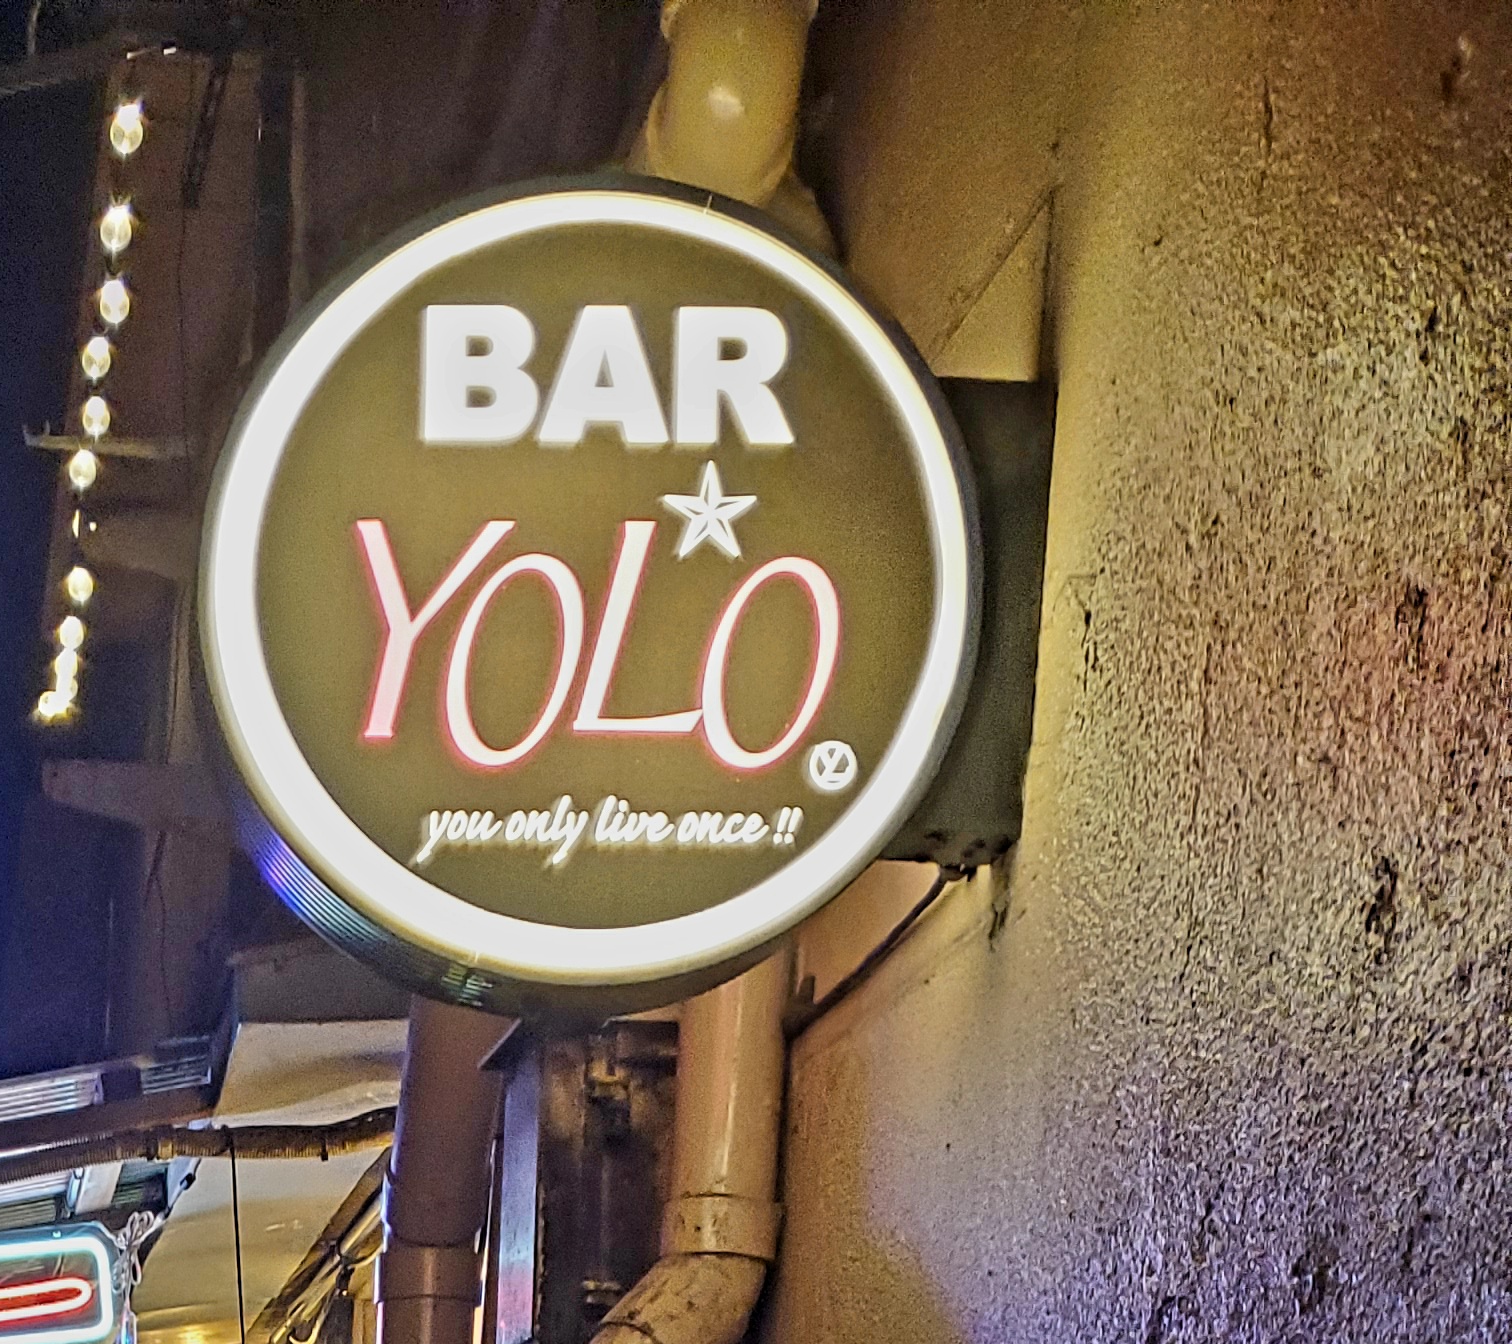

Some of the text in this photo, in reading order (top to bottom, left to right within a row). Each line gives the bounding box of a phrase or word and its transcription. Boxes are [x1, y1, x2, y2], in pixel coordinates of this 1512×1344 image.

[422, 304, 795, 445] BAR
[355, 517, 842, 770] YOLO
[416, 809, 503, 864] you
[504, 794, 589, 864] only
[594, 794, 675, 843] live
[676, 810, 769, 844] once
